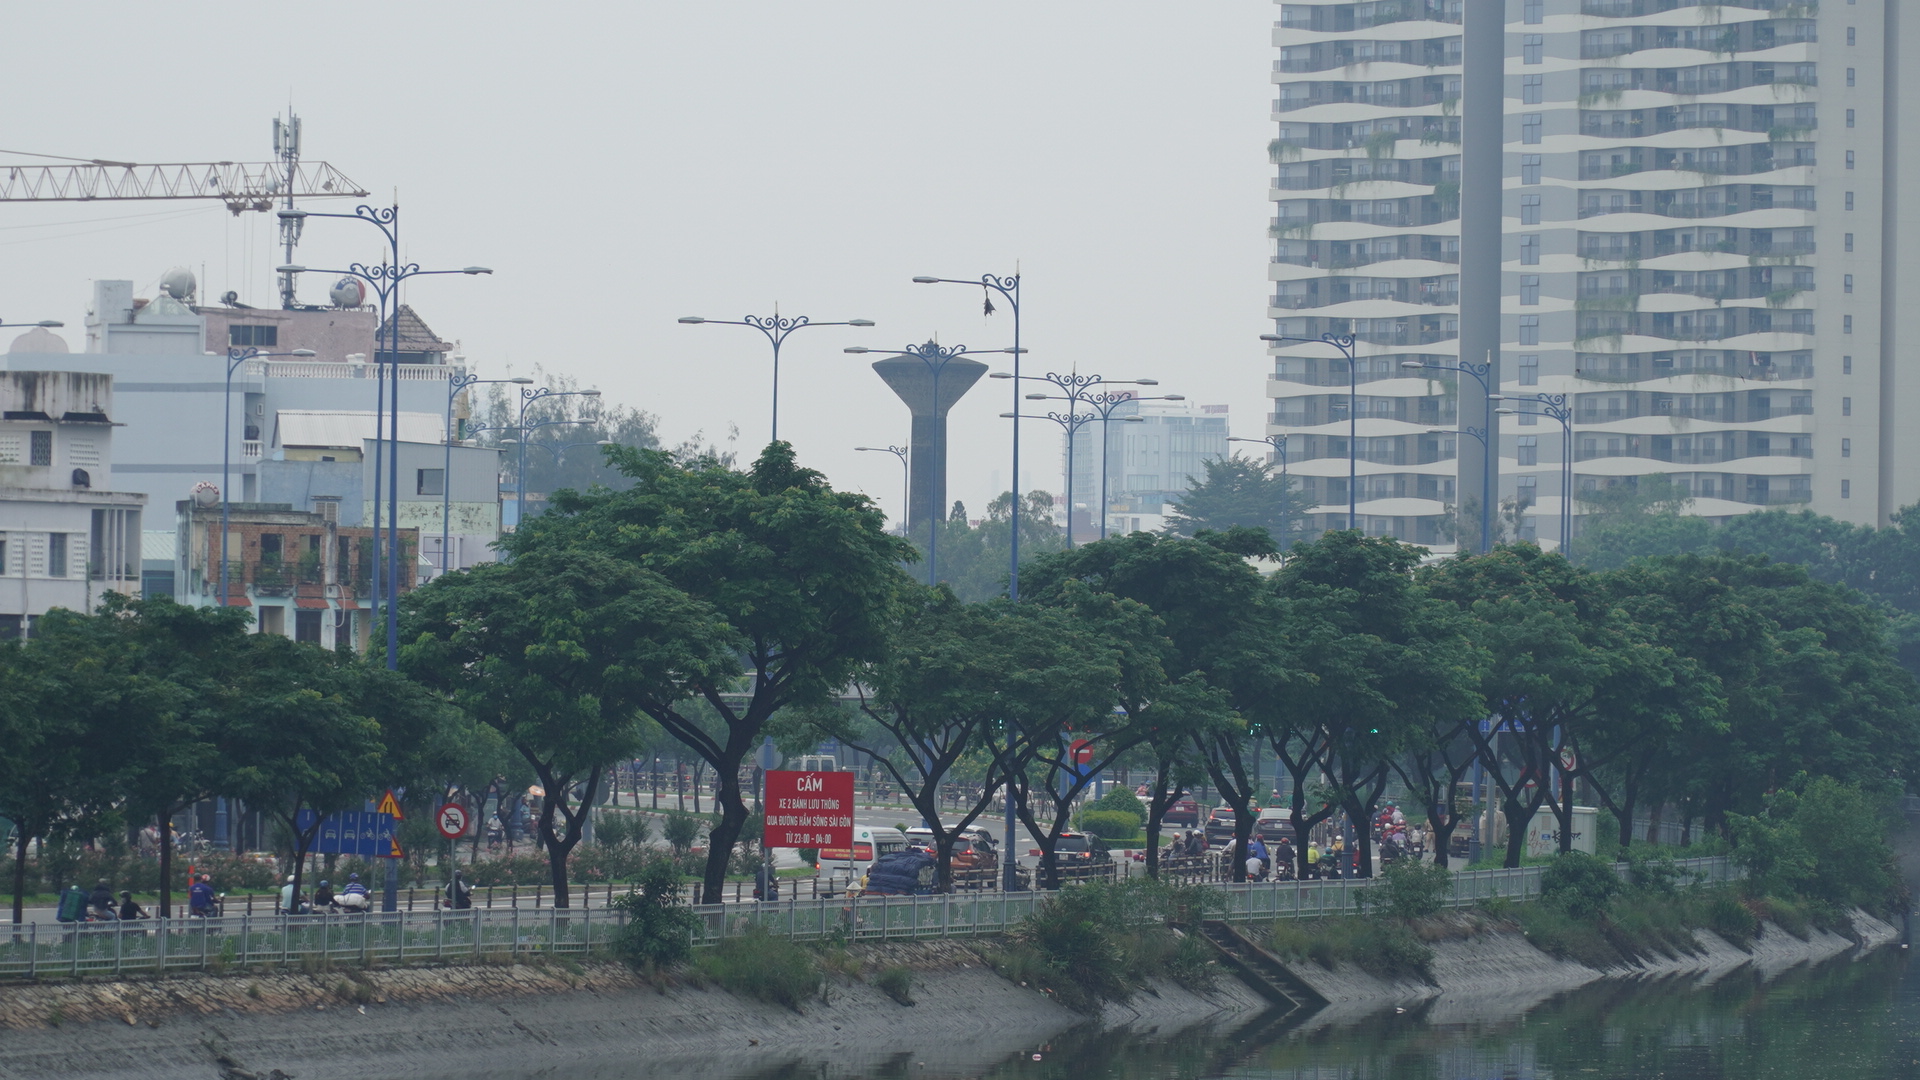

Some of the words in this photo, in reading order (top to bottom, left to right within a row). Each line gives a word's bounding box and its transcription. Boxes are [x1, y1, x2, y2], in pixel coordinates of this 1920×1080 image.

[797, 773, 822, 791] CẤM
[779, 798, 786, 808] XE
[787, 798, 791, 808] 2
[792, 797, 807, 809] BÁNH
[821, 798, 839, 810] THÔNG
[767, 815, 778, 826] QUA
[812, 814, 828, 827] SÔNG
[829, 815, 838, 827] SÀI
[839, 815, 851, 828] GÒN
[794, 833, 810, 844] 23:00
[815, 834, 831, 845] 04:00
